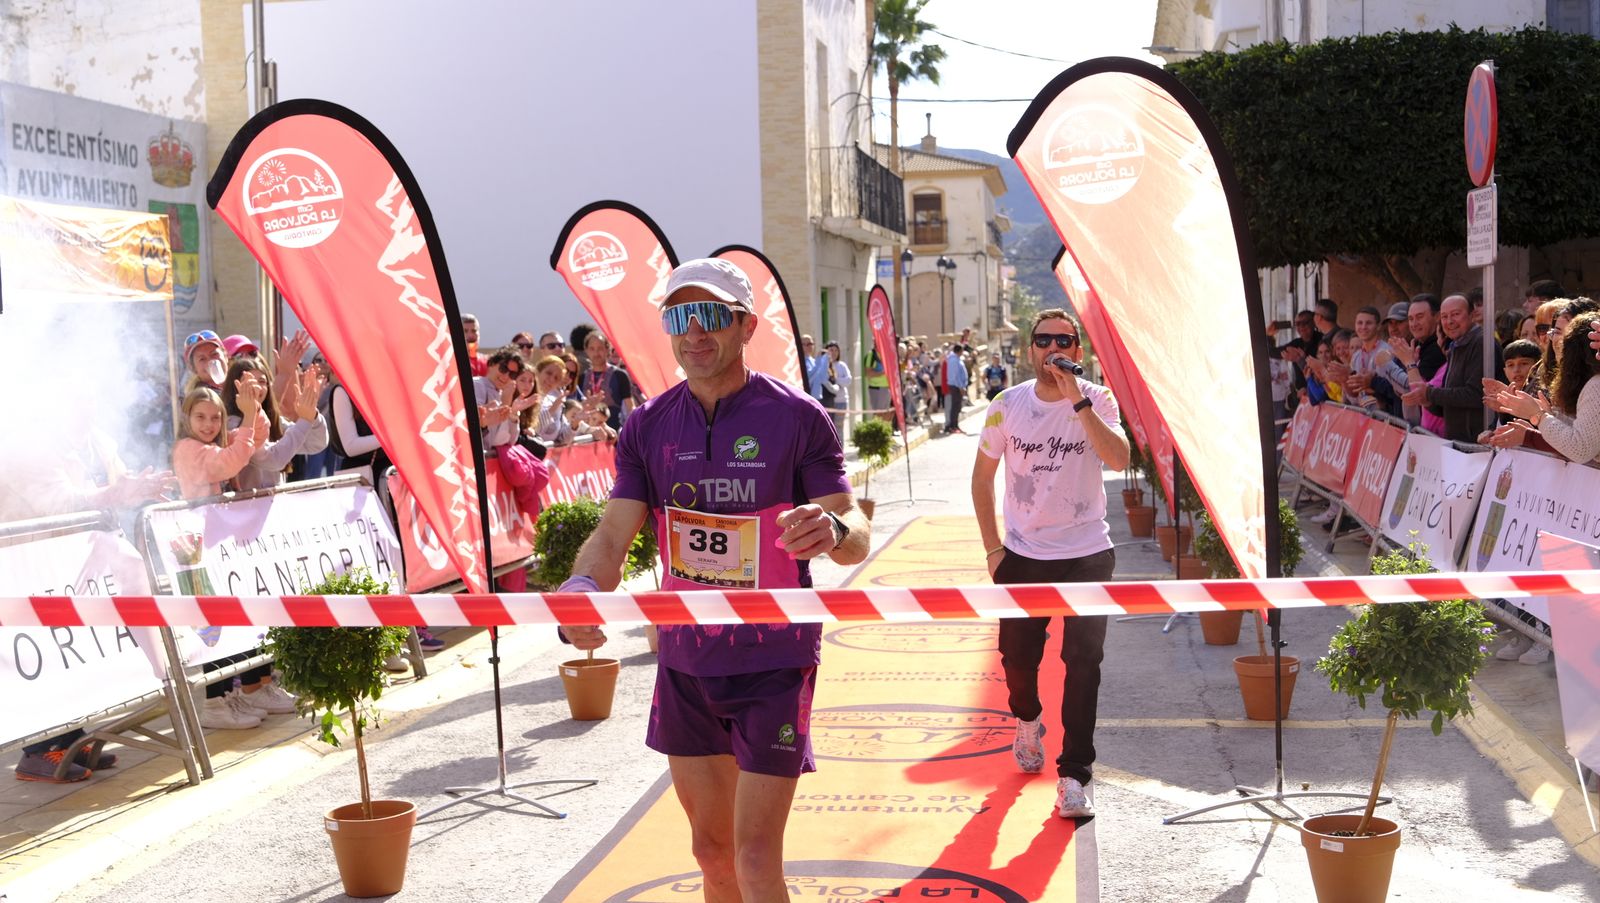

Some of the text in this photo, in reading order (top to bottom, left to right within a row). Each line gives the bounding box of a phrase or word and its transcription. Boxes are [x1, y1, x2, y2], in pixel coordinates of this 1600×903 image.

[12, 122, 138, 169] EXCELENTÍSIMO
[17, 167, 138, 208] AYUNTAMIENTO
[1010, 435, 1085, 460] Pepe Yepes
[1031, 461, 1062, 472] speaker
[699, 478, 756, 503] TBM
[357, 517, 379, 535] DE
[689, 529, 728, 555] 38
[793, 794, 972, 803] de Cantor
[792, 804, 992, 815] Ayuntamie
[919, 886, 981, 899] LA
